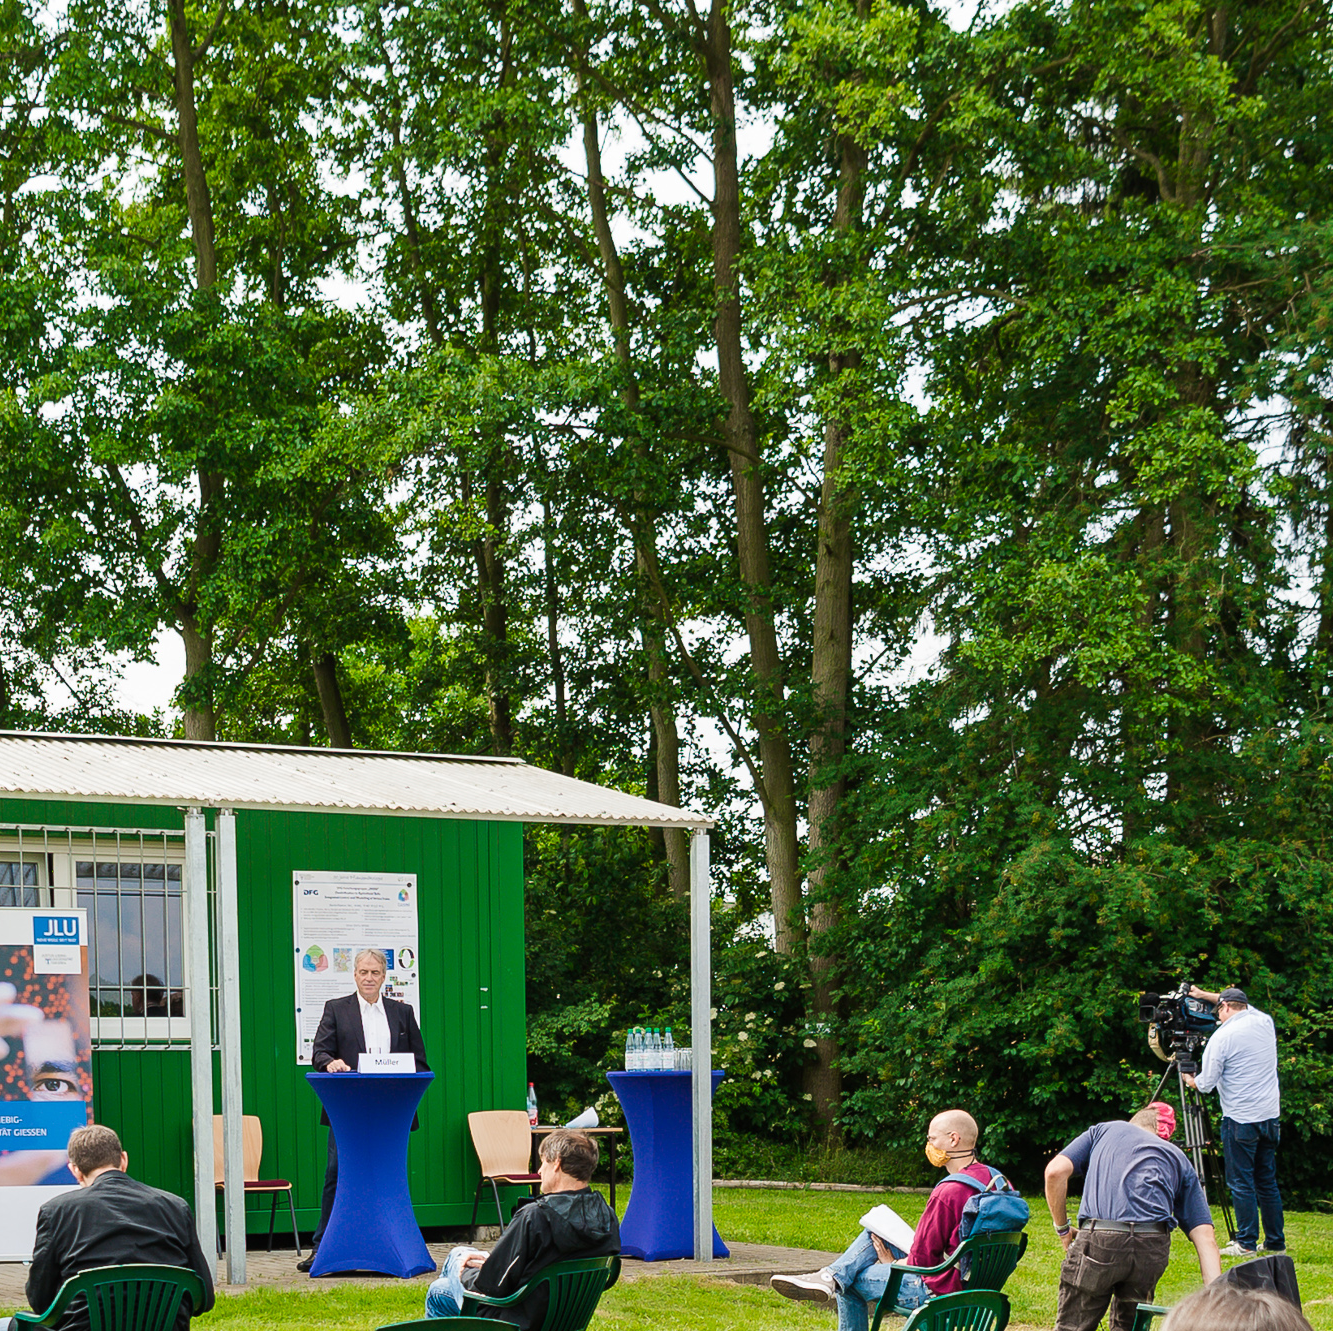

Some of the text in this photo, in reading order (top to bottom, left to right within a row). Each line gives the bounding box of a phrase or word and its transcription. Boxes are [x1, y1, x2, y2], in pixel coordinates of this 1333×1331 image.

[43, 918, 77, 936] JLU
[375, 1058, 399, 1066] Müller
[13, 1128, 47, 1137] GIESSEN
